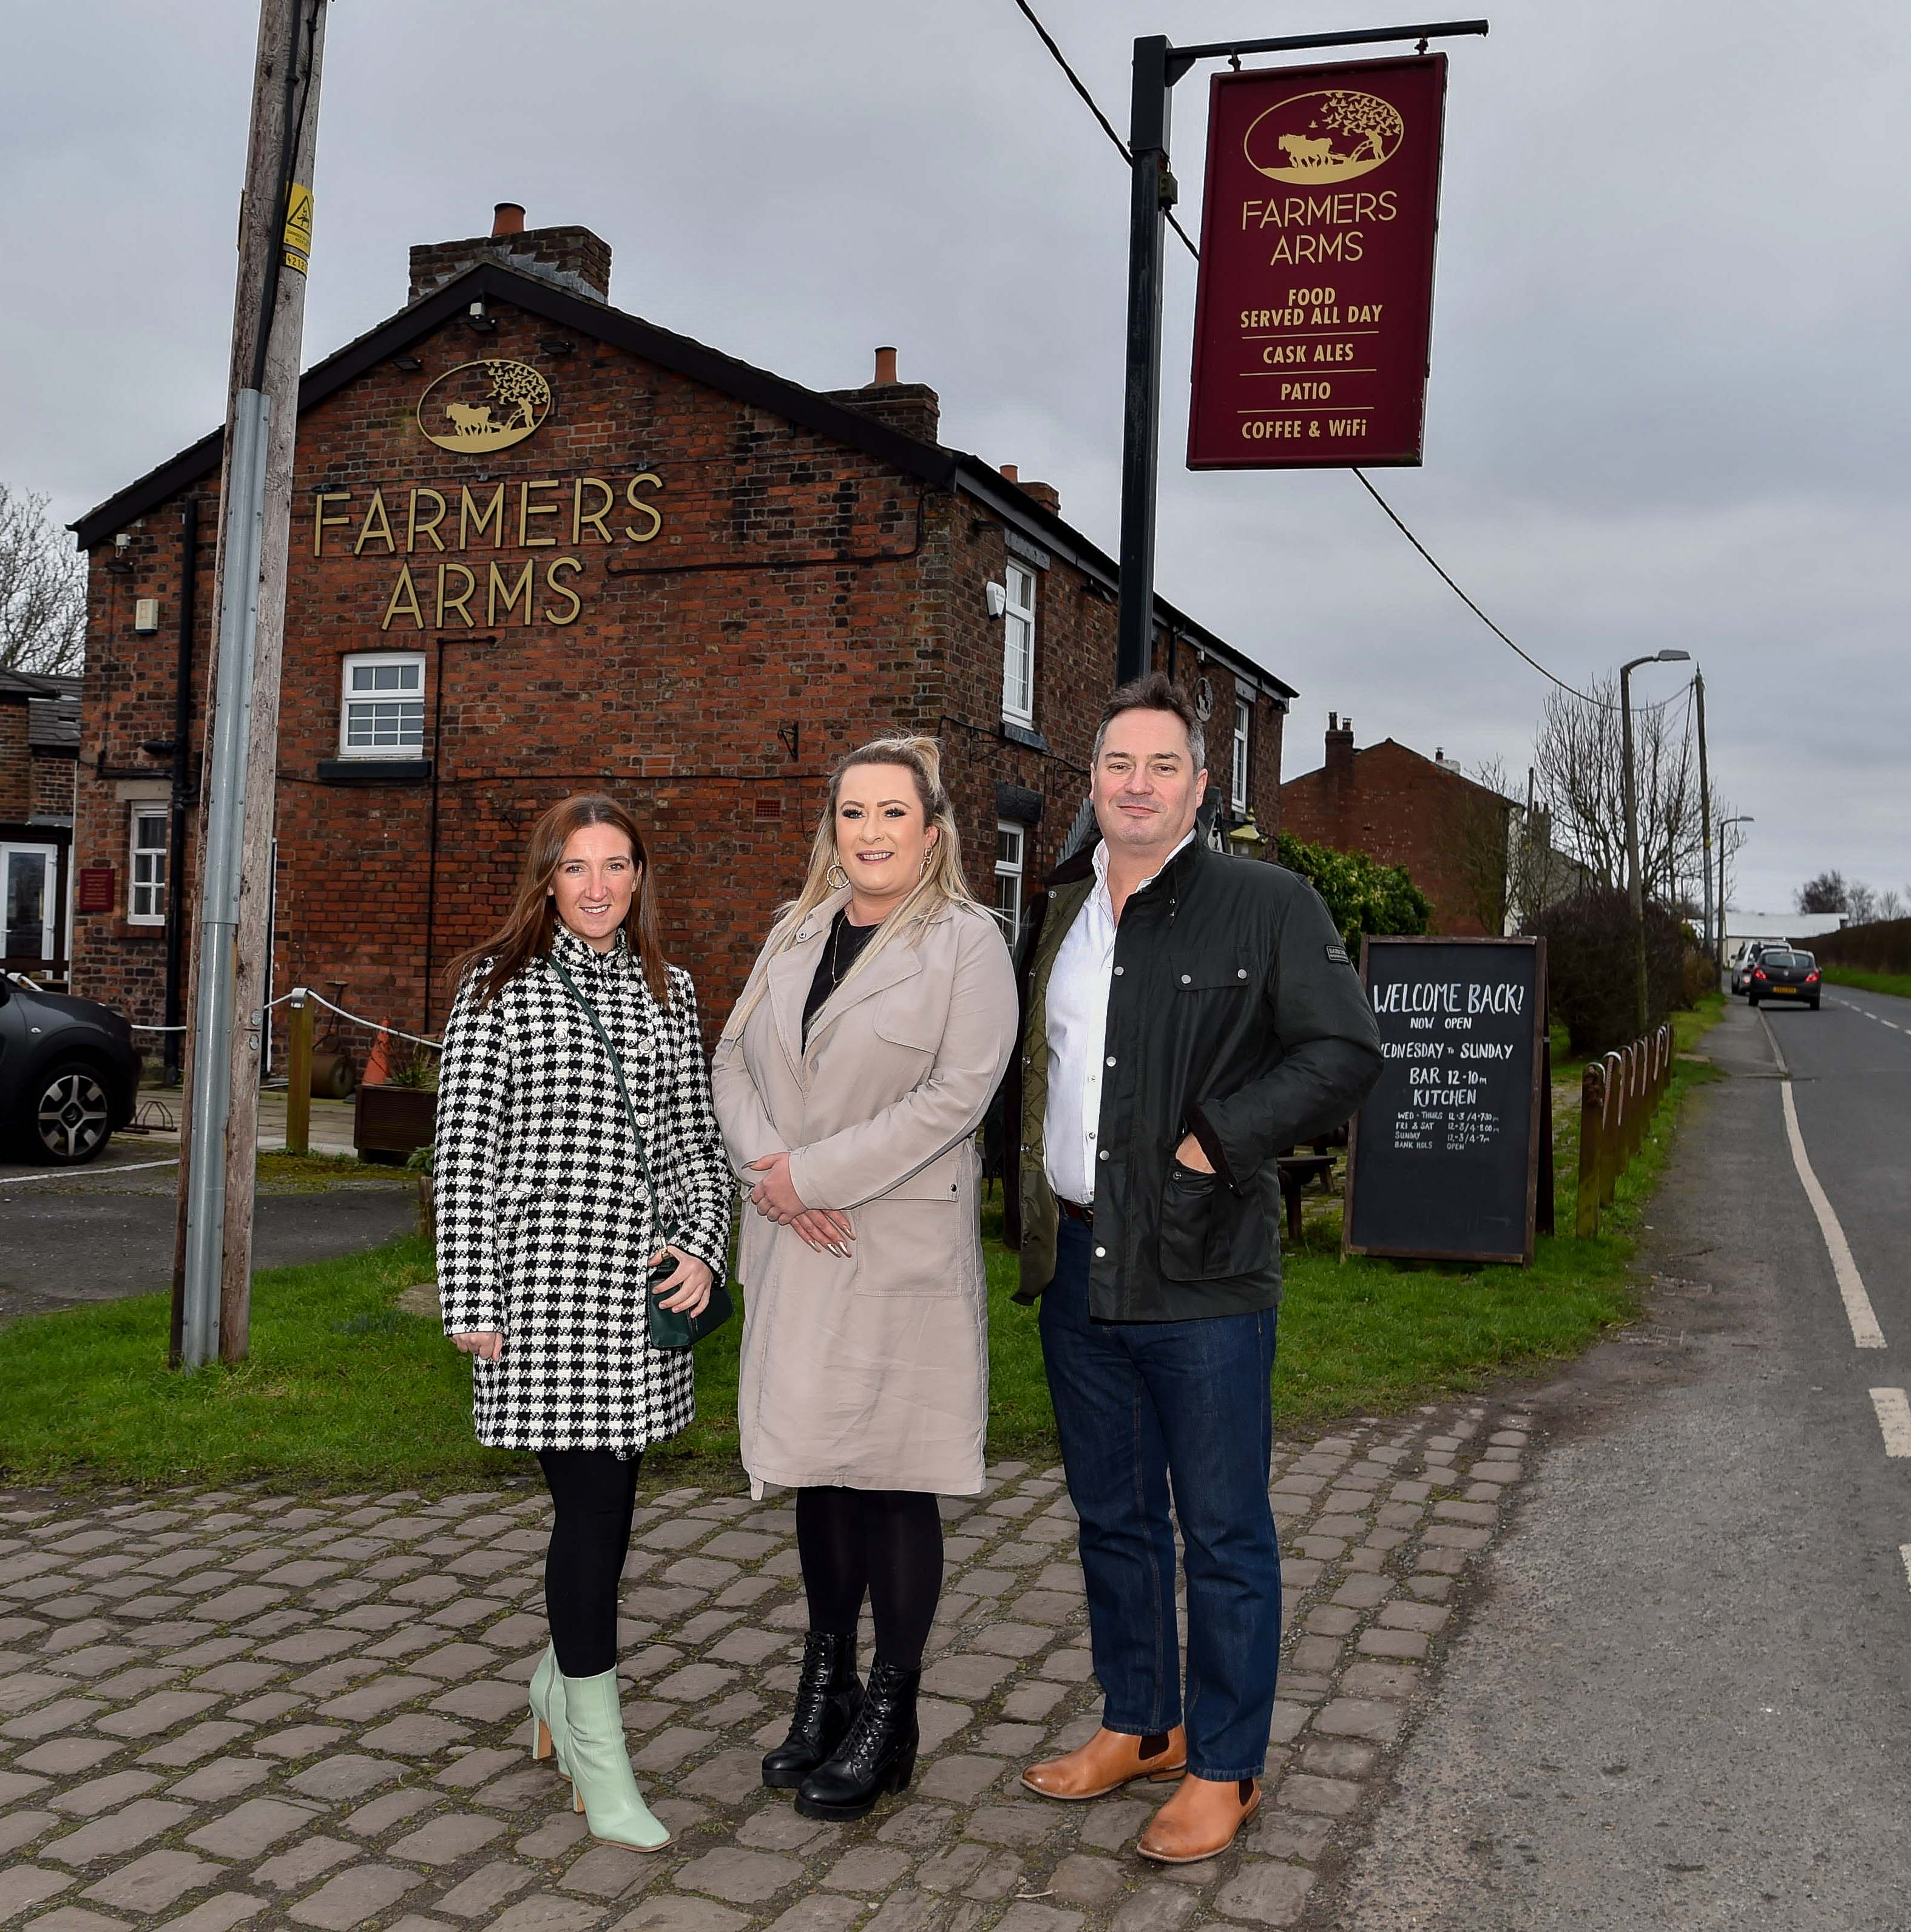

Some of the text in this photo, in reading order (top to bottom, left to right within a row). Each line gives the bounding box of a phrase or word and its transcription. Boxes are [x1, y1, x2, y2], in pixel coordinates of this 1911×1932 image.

[1242, 191, 1398, 231] FARMERS
[1270, 231, 1364, 266] ARMS
[1288, 288, 1336, 306] FOOD
[1240, 305, 1383, 328] SERVED ALL DAY
[1263, 343, 1354, 363] CASK ALES
[1281, 382, 1331, 400] PATIO
[1242, 419, 1367, 439] COFFEE & WiFi
[314, 473, 663, 556] FARMERS
[381, 556, 583, 631] ARMS
[1373, 983, 1524, 1015] WELCOME BACK!
[1410, 1016, 1472, 1029] NOW OPEN
[1460, 1042, 1514, 1059] SUNDAY
[1409, 1067, 1441, 1084] BAR
[1413, 1089, 1476, 1107] KITCHEN
[1398, 1111, 1414, 1120] WED
[1421, 1111, 1443, 1120] THURS
[1396, 1121, 1408, 1130] FRI
[1420, 1121, 1435, 1130] SAT
[1395, 1130, 1421, 1140] SUNDAY
[1416, 1141, 1433, 1149] HOLS
